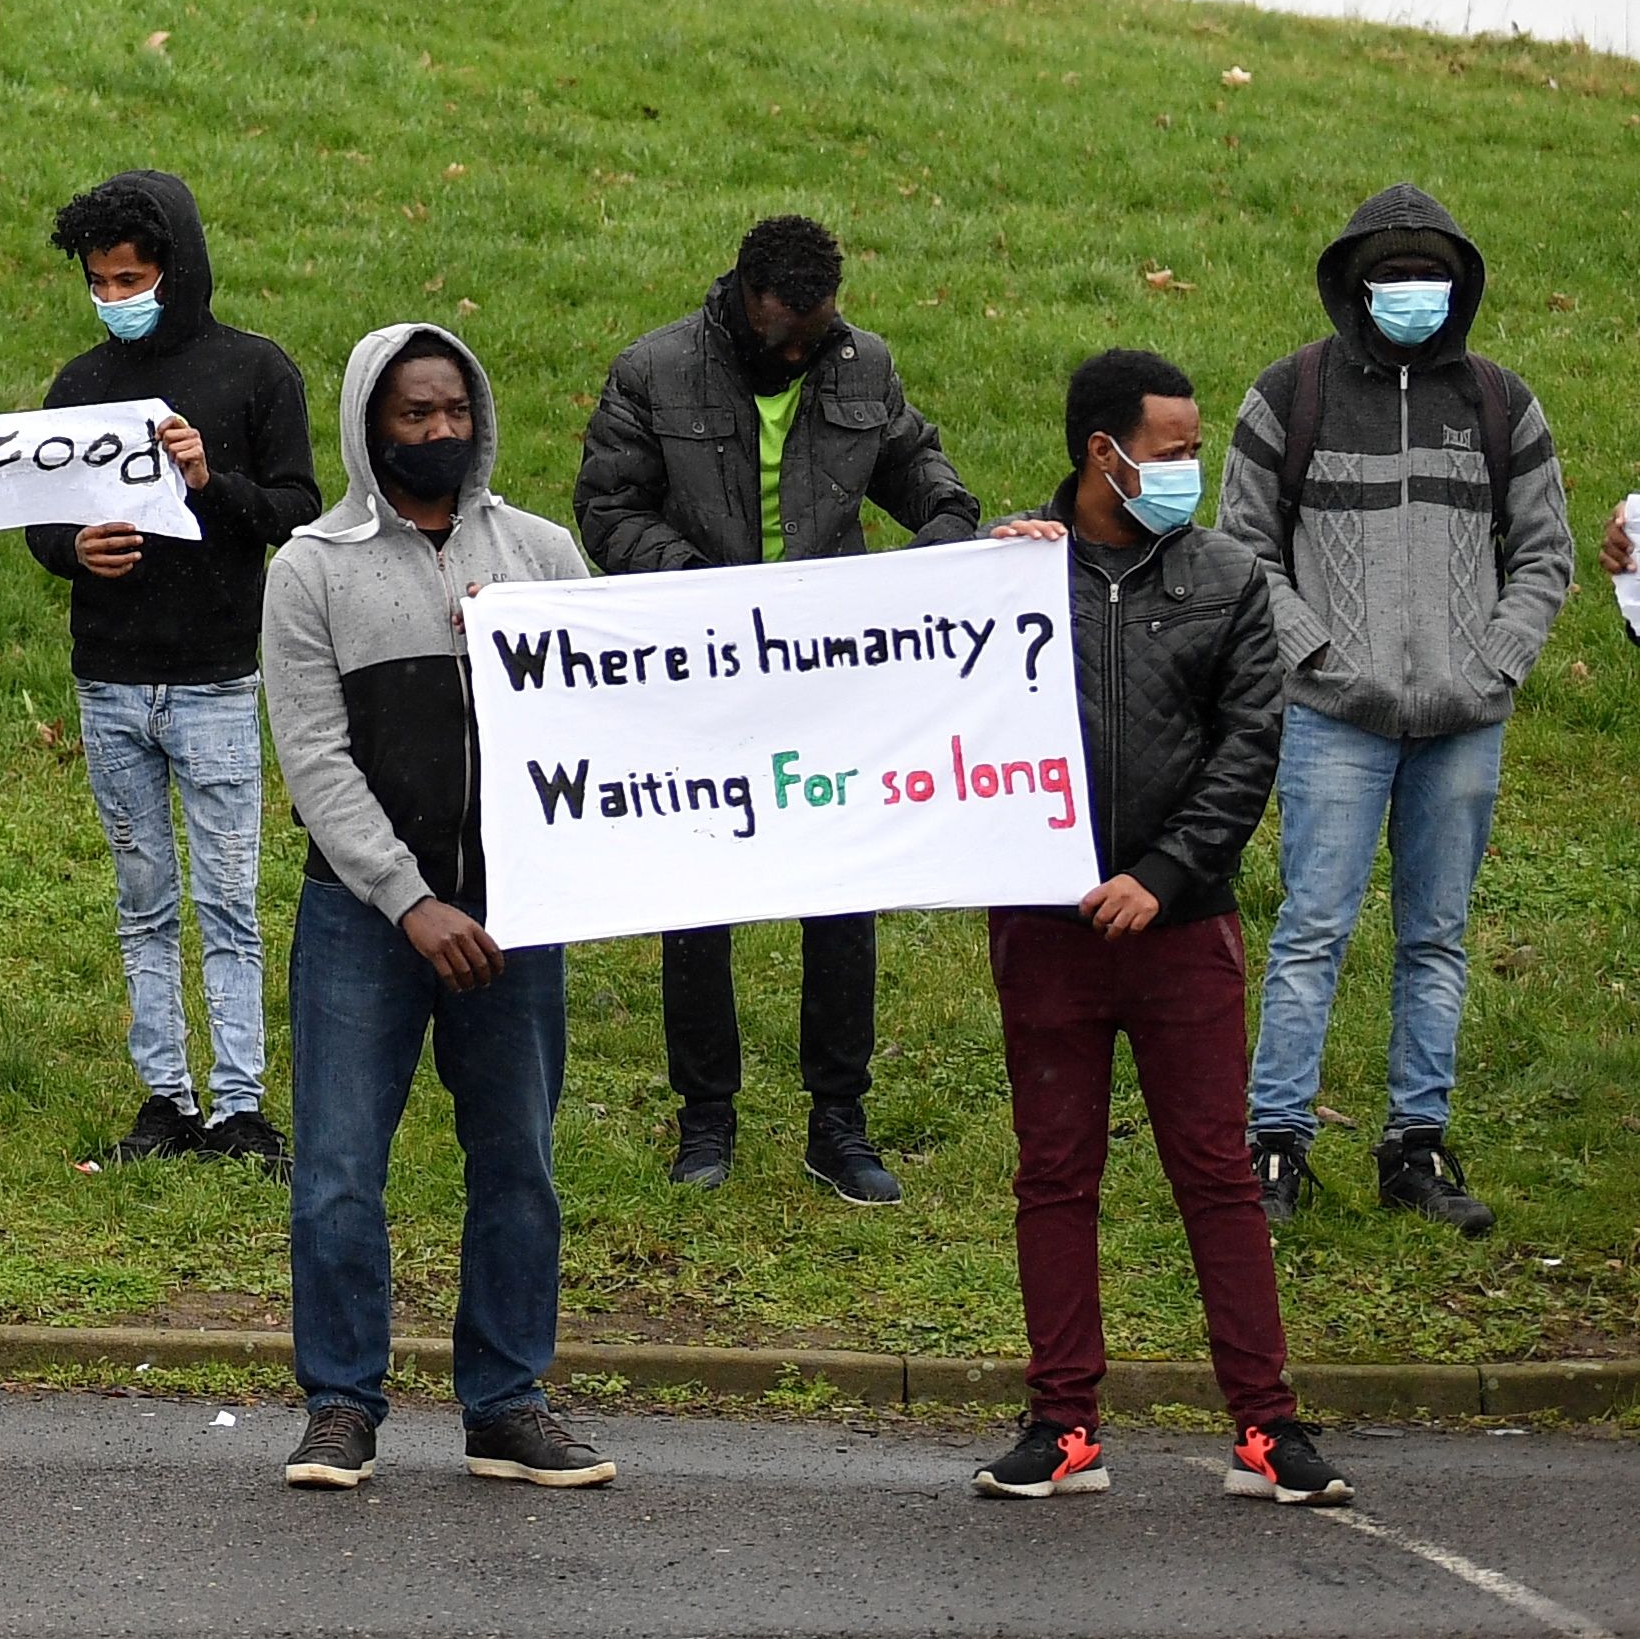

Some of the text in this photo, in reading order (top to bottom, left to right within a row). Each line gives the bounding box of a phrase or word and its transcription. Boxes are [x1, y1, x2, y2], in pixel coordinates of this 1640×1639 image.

[492, 629, 689, 691] Where
[706, 629, 740, 677] is
[752, 607, 995, 679] humanity
[527, 735, 1075, 838] Waiting For so long
